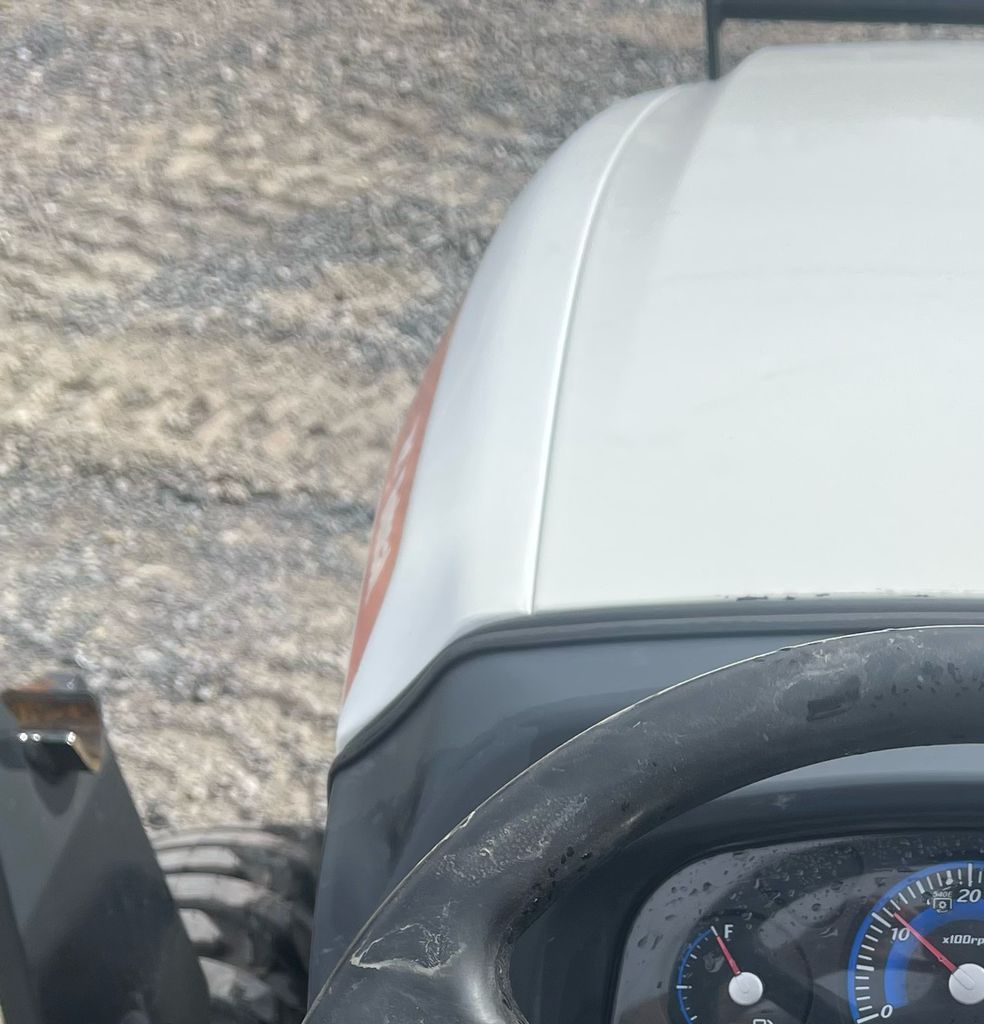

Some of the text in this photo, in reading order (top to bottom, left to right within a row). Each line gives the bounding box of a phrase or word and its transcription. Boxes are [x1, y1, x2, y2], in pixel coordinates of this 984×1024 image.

[957, 889, 981, 902] 20
[724, 924, 734, 938] F
[891, 928, 910, 941] 10
[880, 1005, 893, 1018] 0
